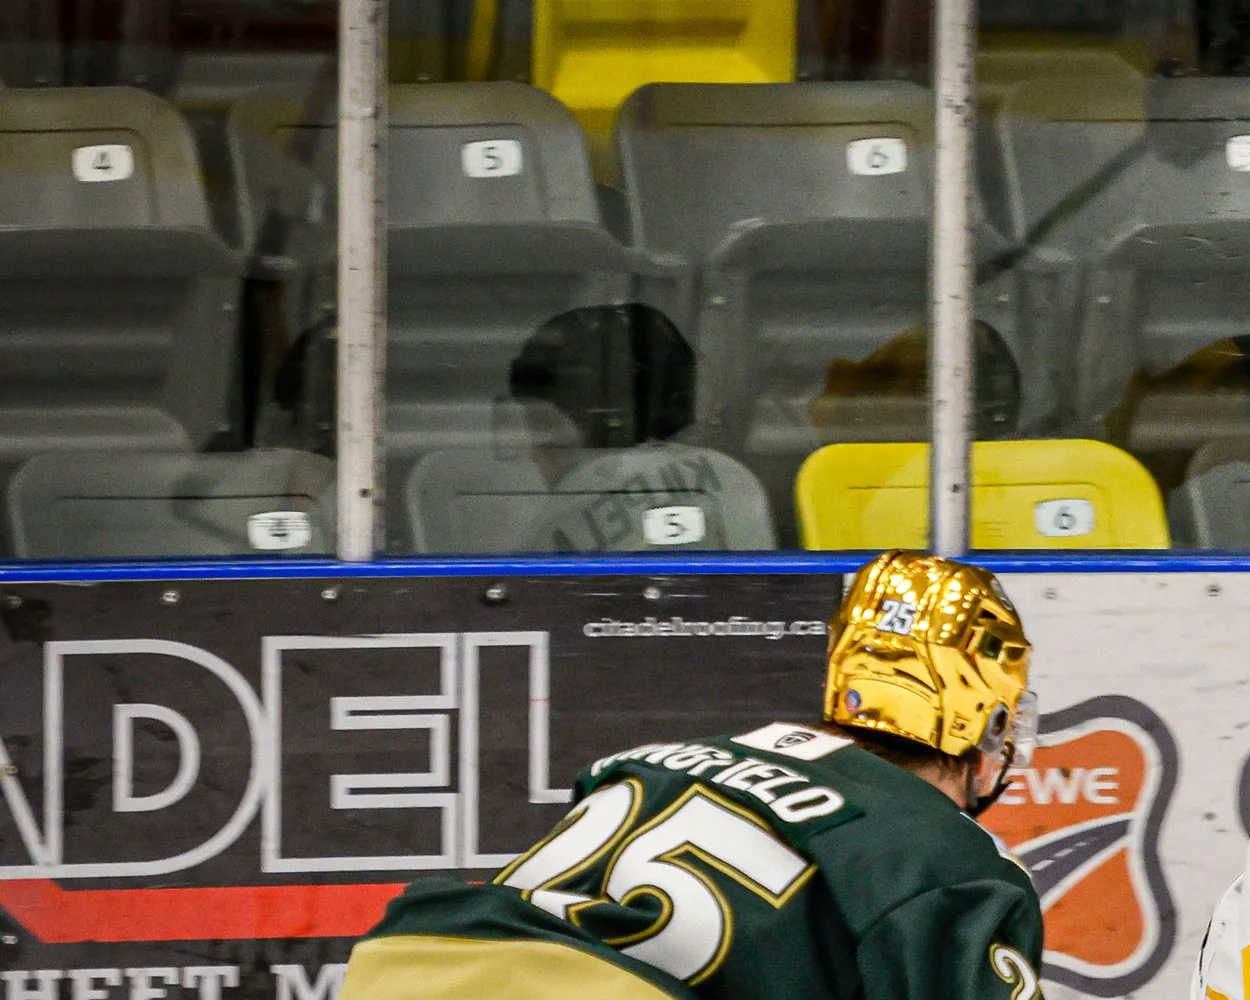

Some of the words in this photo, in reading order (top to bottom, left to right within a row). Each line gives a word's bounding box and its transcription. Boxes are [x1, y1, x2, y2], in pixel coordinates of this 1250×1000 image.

[94, 152, 113, 174] 4
[482, 147, 502, 170] 5
[865, 144, 888, 168] 6
[270, 518, 289, 542] 4
[663, 514, 686, 537] 5
[1054, 506, 1077, 530] 6
[583, 616, 827, 641] citadelroofing.ca
[876, 599, 918, 636] 25
[492, 776, 818, 986] 25
